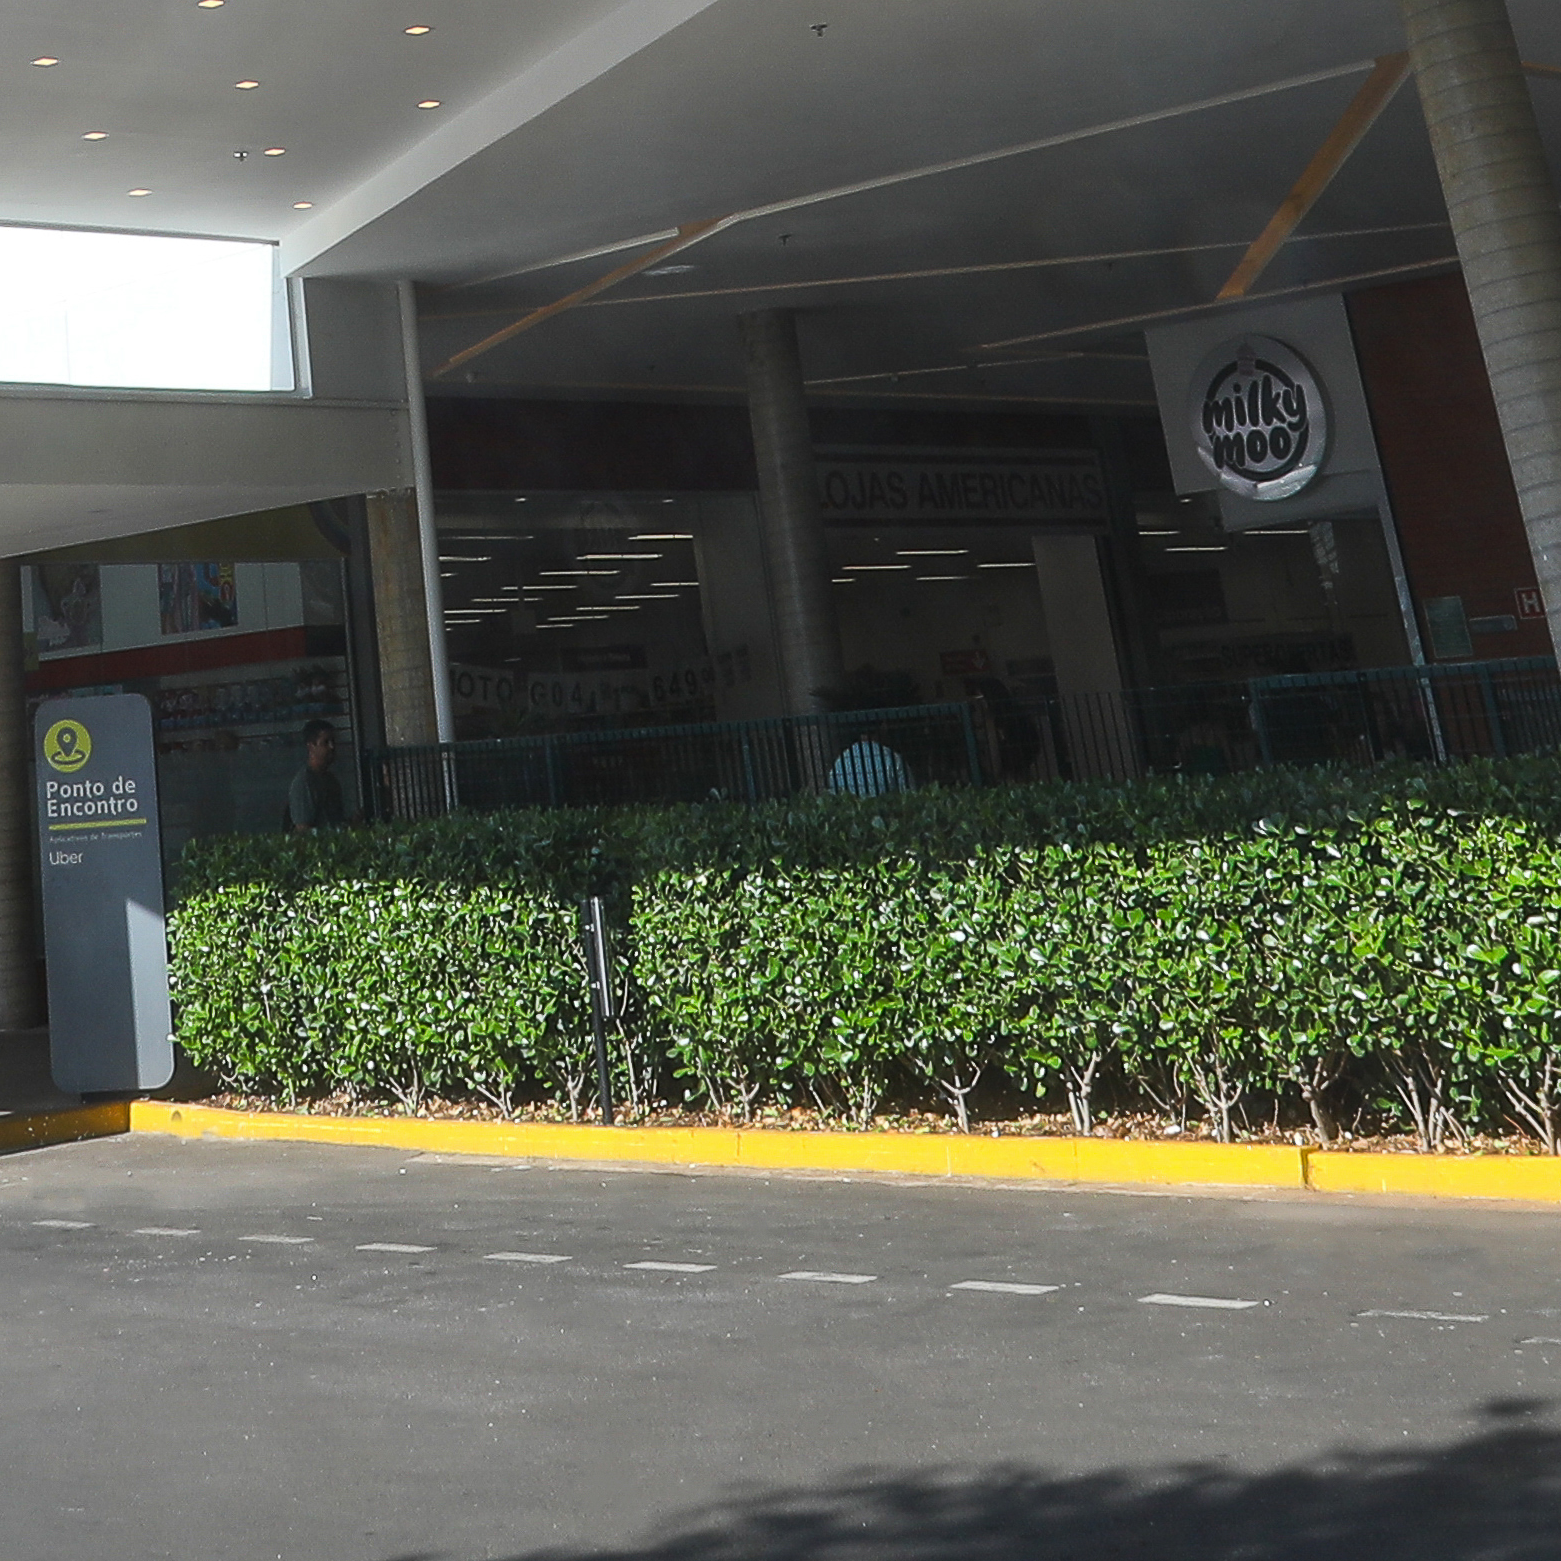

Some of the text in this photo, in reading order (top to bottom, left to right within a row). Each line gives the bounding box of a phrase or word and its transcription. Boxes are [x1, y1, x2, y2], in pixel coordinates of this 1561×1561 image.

[1203, 374, 1307, 433] milky
[1213, 426, 1291, 470] moo
[821, 470, 1104, 510] OJAS AMERICANAS
[1521, 591, 1541, 613] H
[46, 775, 136, 798] Ponto de
[47, 796, 138, 817] Encontro
[49, 851, 83, 866] Uber
